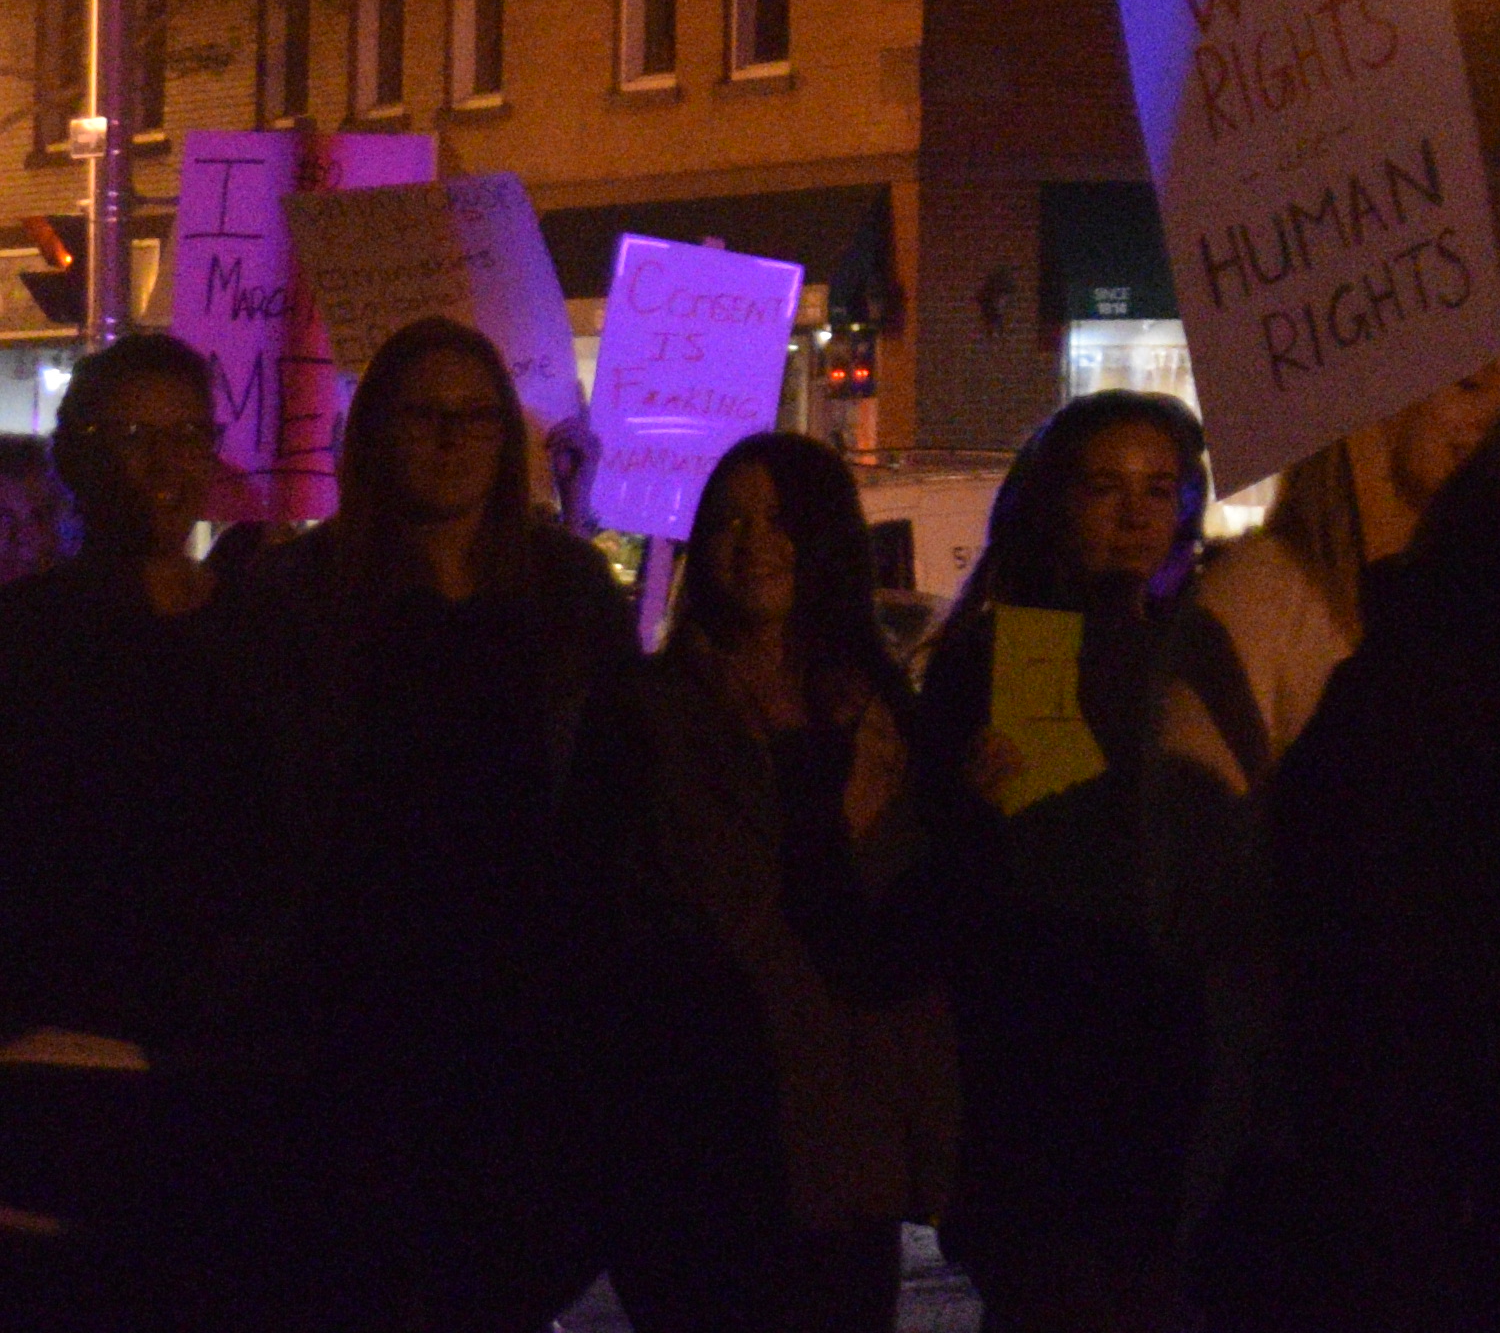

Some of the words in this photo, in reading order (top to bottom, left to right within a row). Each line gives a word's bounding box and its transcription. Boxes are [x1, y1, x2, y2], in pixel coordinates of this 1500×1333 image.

[185, 155, 264, 241] I
[1201, 139, 1445, 308] HUMAN
[1259, 227, 1471, 391] RIGHTS
